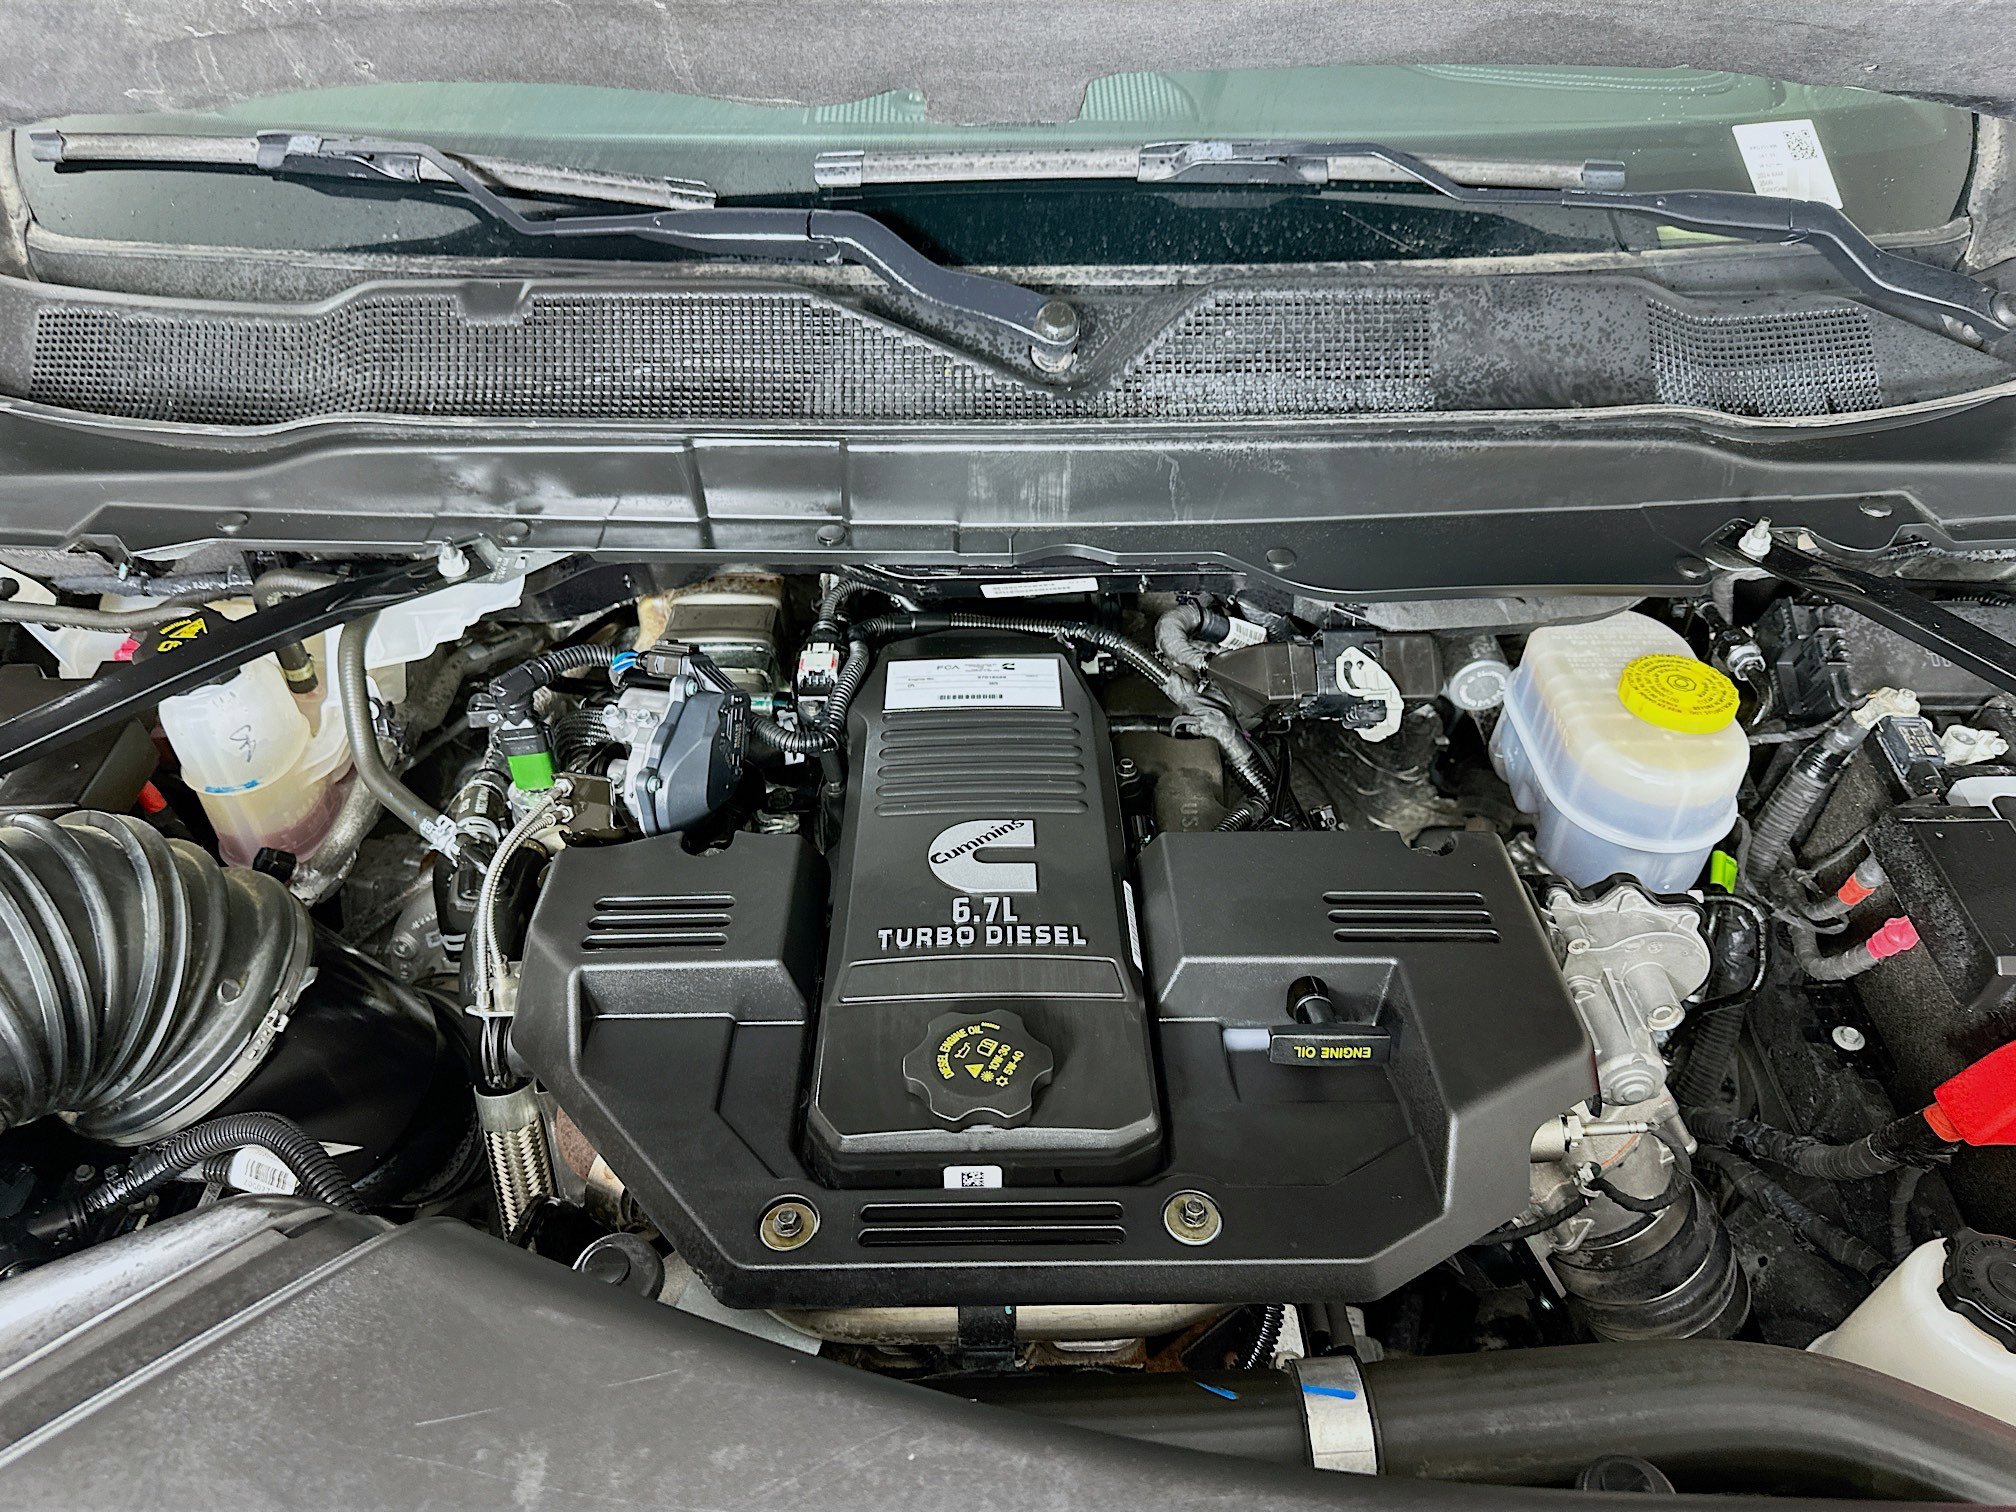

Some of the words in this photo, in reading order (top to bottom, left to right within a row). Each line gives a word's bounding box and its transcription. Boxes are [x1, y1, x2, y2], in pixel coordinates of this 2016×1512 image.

[930, 819, 1025, 865] Cummins
[952, 896, 1018, 924] 6.7L
[877, 925, 976, 950] TURBO
[985, 925, 1087, 947] DIESEL
[939, 1028, 968, 1052] ENGINE
[968, 1025, 984, 1035] OIL
[988, 1044, 1012, 1071] 10W-30
[1003, 1050, 1024, 1075] 5W-40
[1293, 1046, 1316, 1058] OIL
[1321, 1047, 1371, 1058] ENGINE
